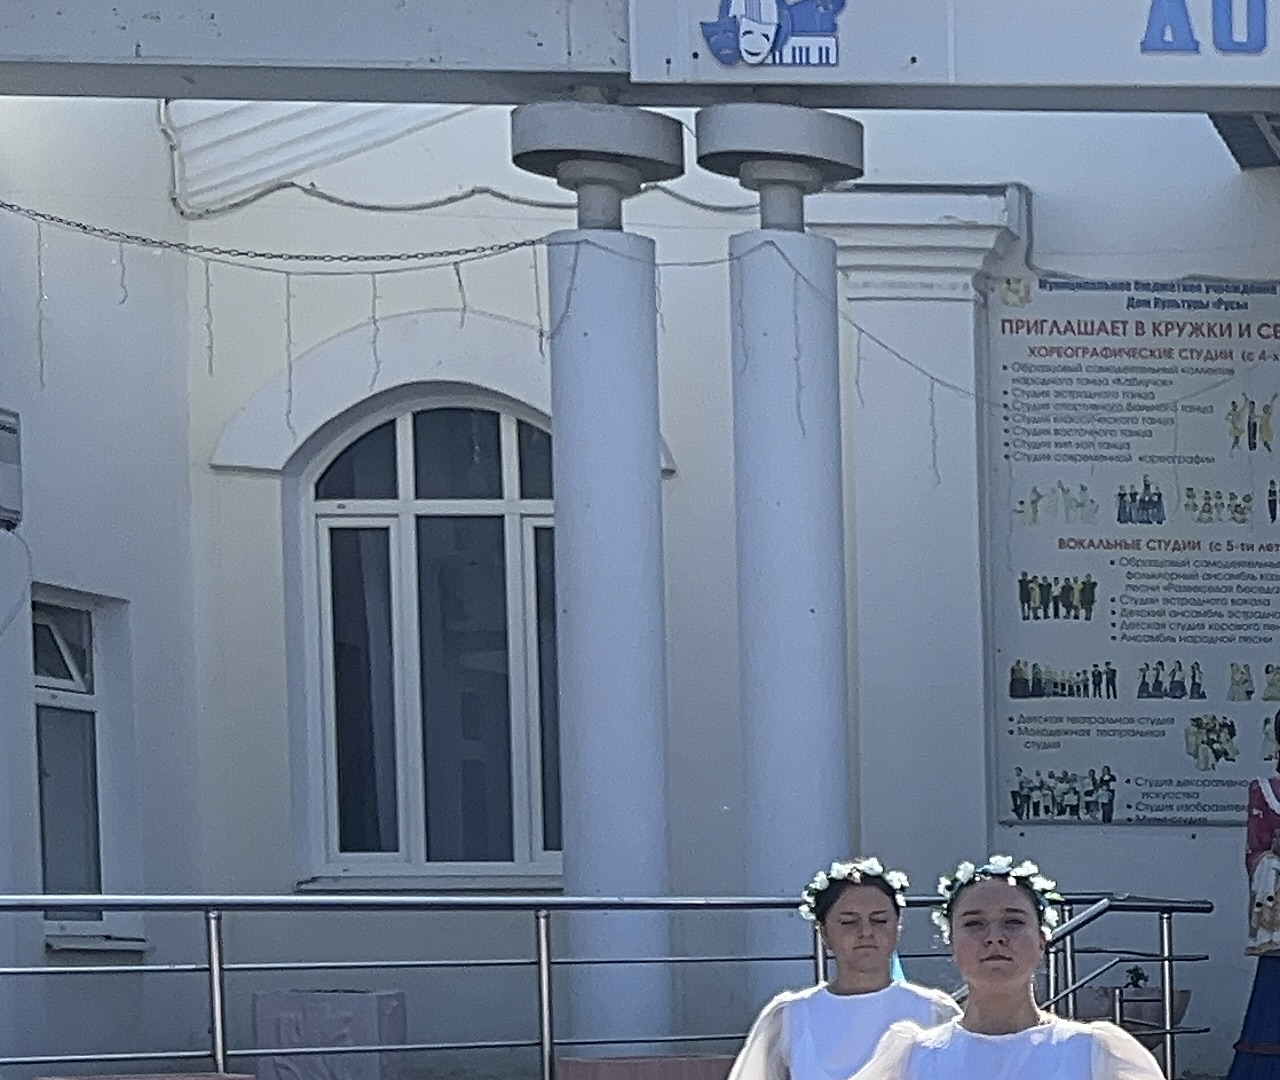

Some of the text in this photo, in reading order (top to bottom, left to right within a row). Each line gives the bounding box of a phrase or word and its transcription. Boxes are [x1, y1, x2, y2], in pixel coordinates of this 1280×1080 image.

[1001, 318, 1128, 336] ПРИГЛАШАЕТ
[1135, 320, 1146, 336] В
[1152, 320, 1232, 338] КРУЖКИ
[1238, 322, 1251, 338] И
[1178, 348, 1233, 362] СТУДИИ
[1058, 538, 1142, 551] ВОКАЛЬНЫЕ
[1146, 539, 1201, 553] СТУДИИ
